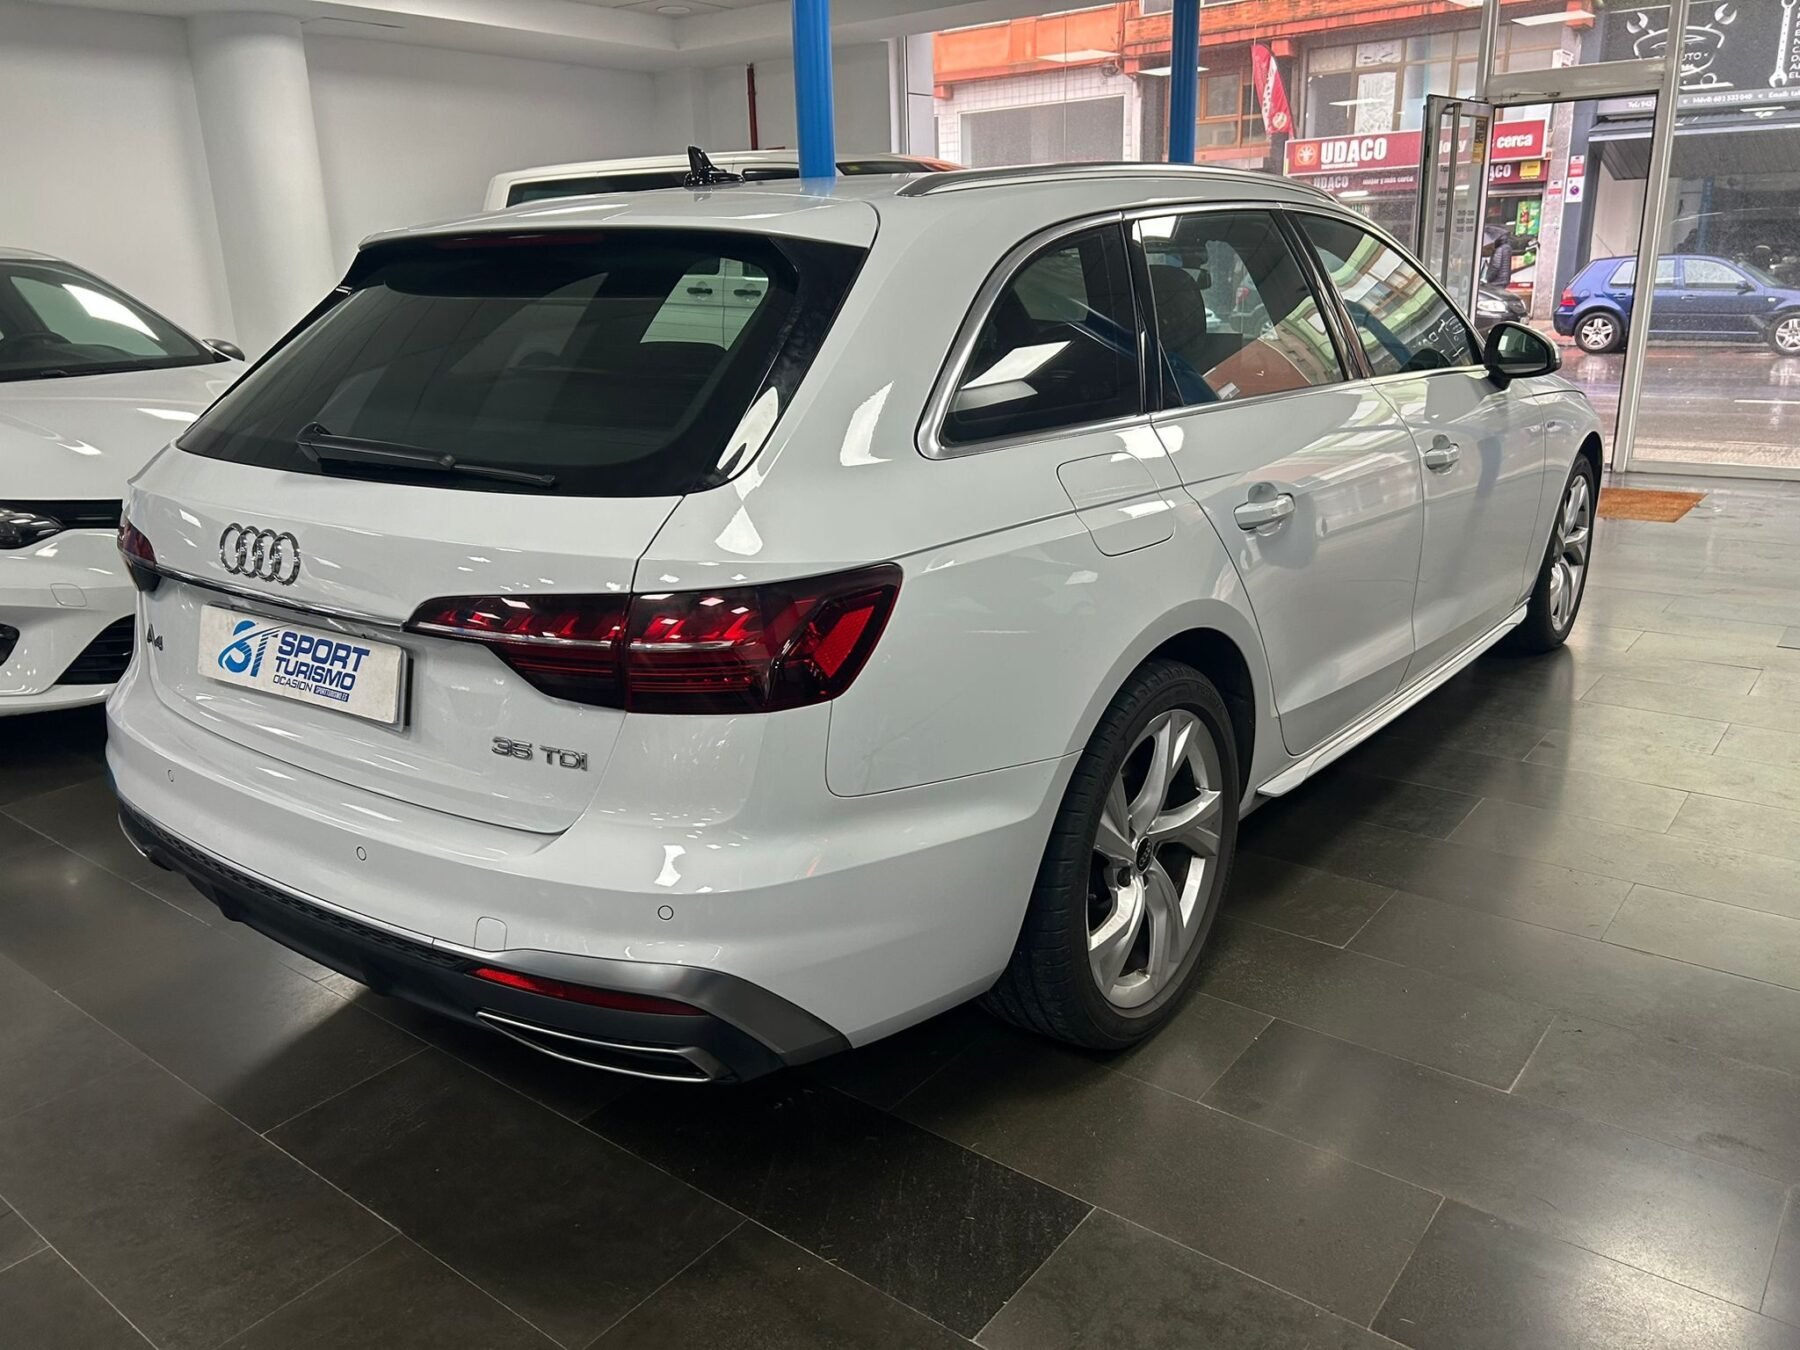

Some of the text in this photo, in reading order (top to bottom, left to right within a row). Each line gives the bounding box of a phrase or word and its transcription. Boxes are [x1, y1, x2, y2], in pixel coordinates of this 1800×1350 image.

[1321, 138, 1387, 163] UDACO
[1497, 133, 1533, 148] cerca
[1313, 175, 1349, 190] UDACO
[278, 631, 370, 672] SPORT
[272, 674, 314, 693] OCASION
[275, 656, 356, 691] TURISMO
[491, 736, 588, 771] 35 TDI
